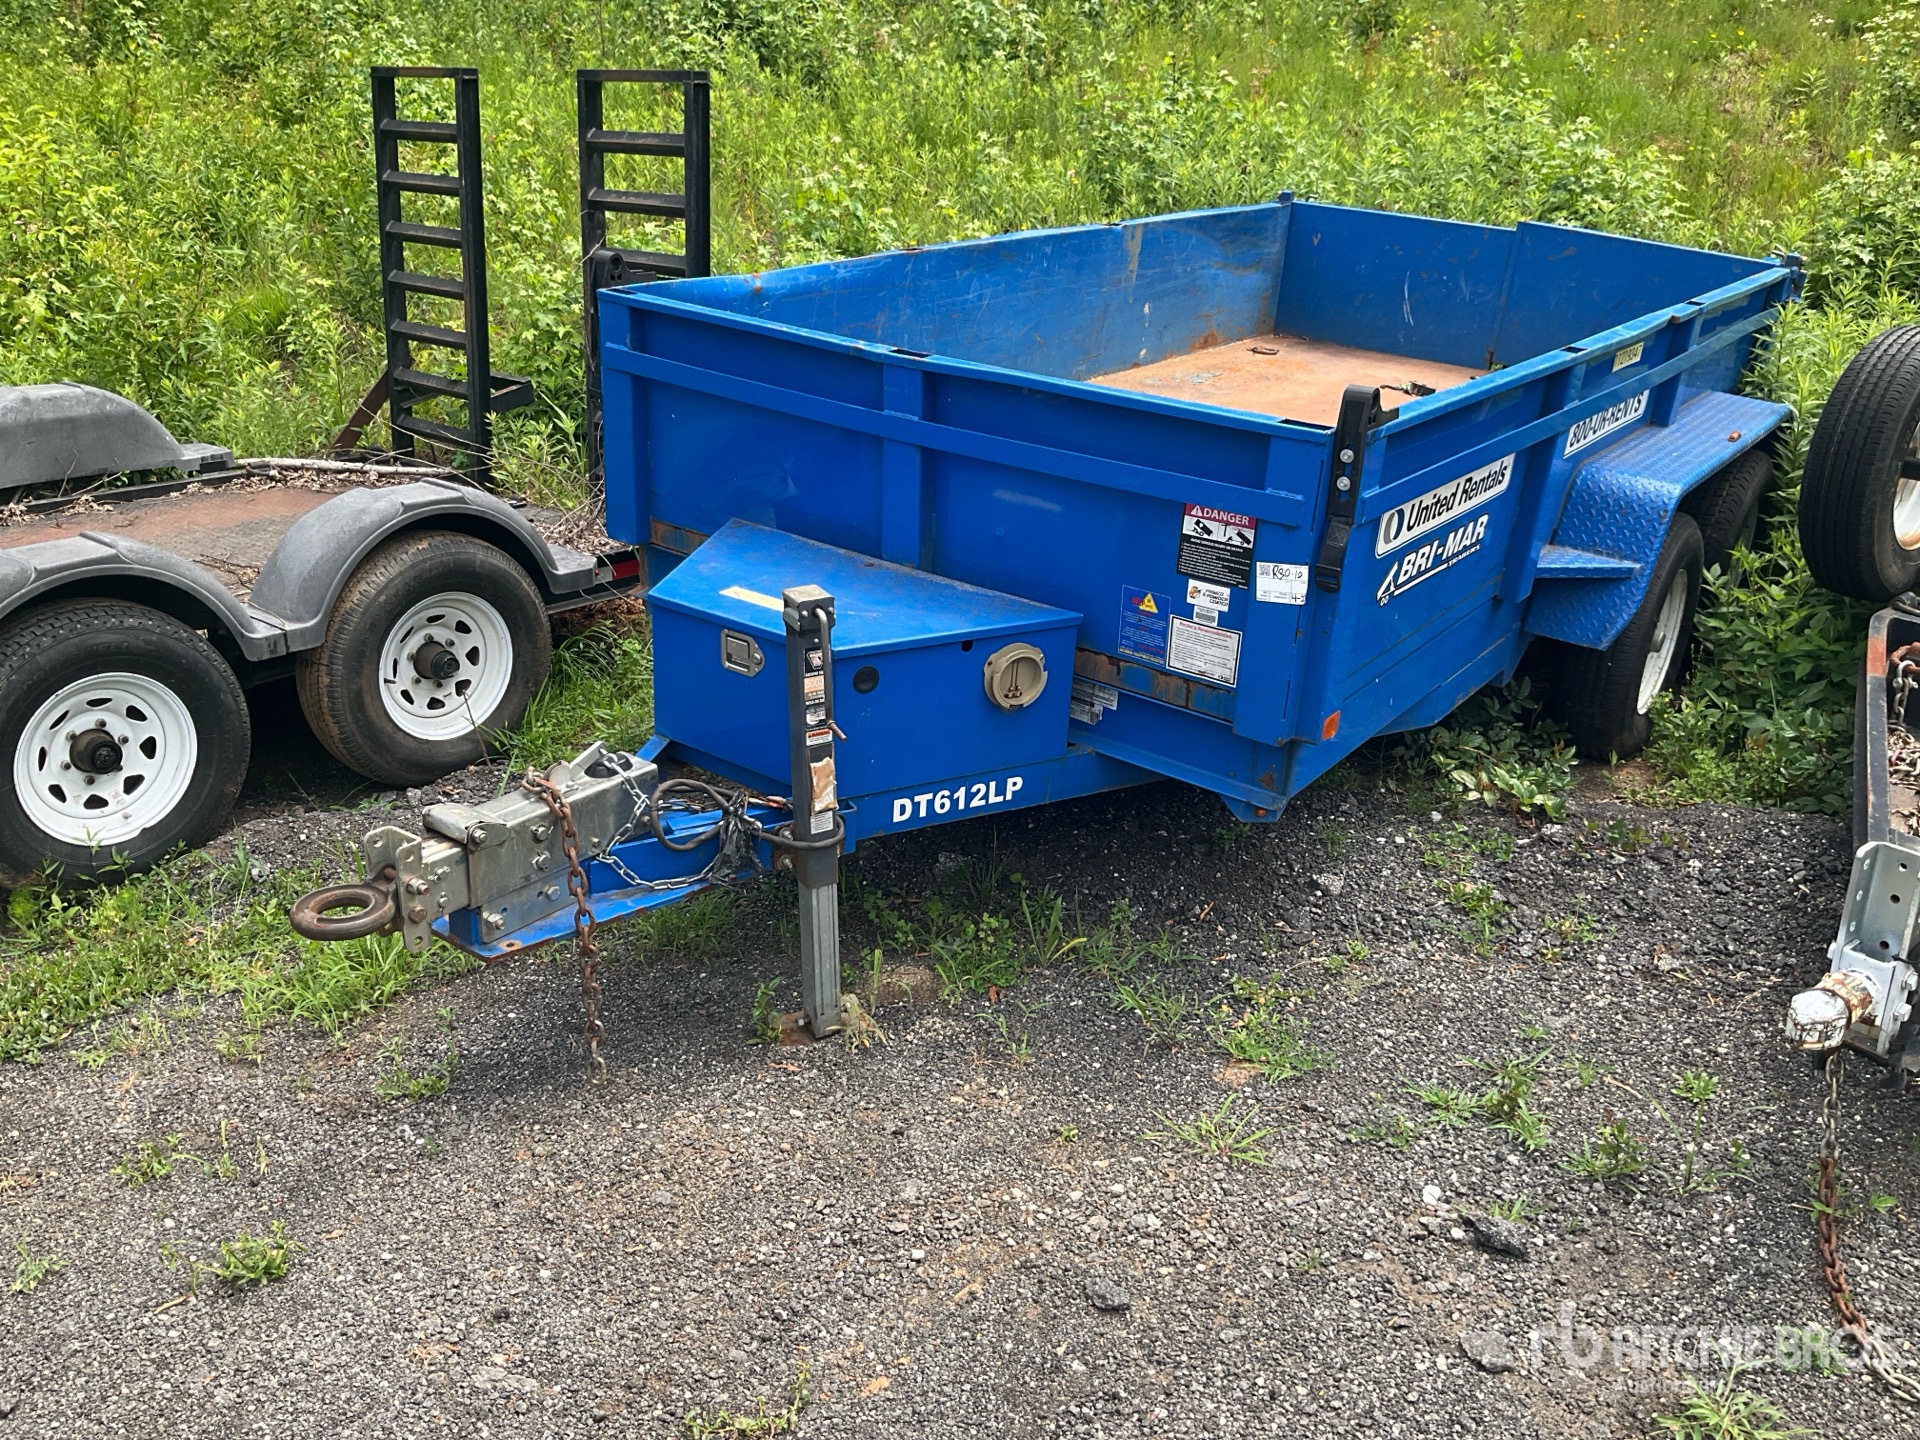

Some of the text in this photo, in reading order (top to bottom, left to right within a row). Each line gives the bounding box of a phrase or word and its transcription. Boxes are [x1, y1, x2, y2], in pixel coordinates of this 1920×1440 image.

[1203, 507, 1250, 526] DANGER
[1406, 460, 1508, 532] United Rentals
[1396, 512, 1489, 586] BRI-MAR
[892, 776, 1024, 823] DT612LP
